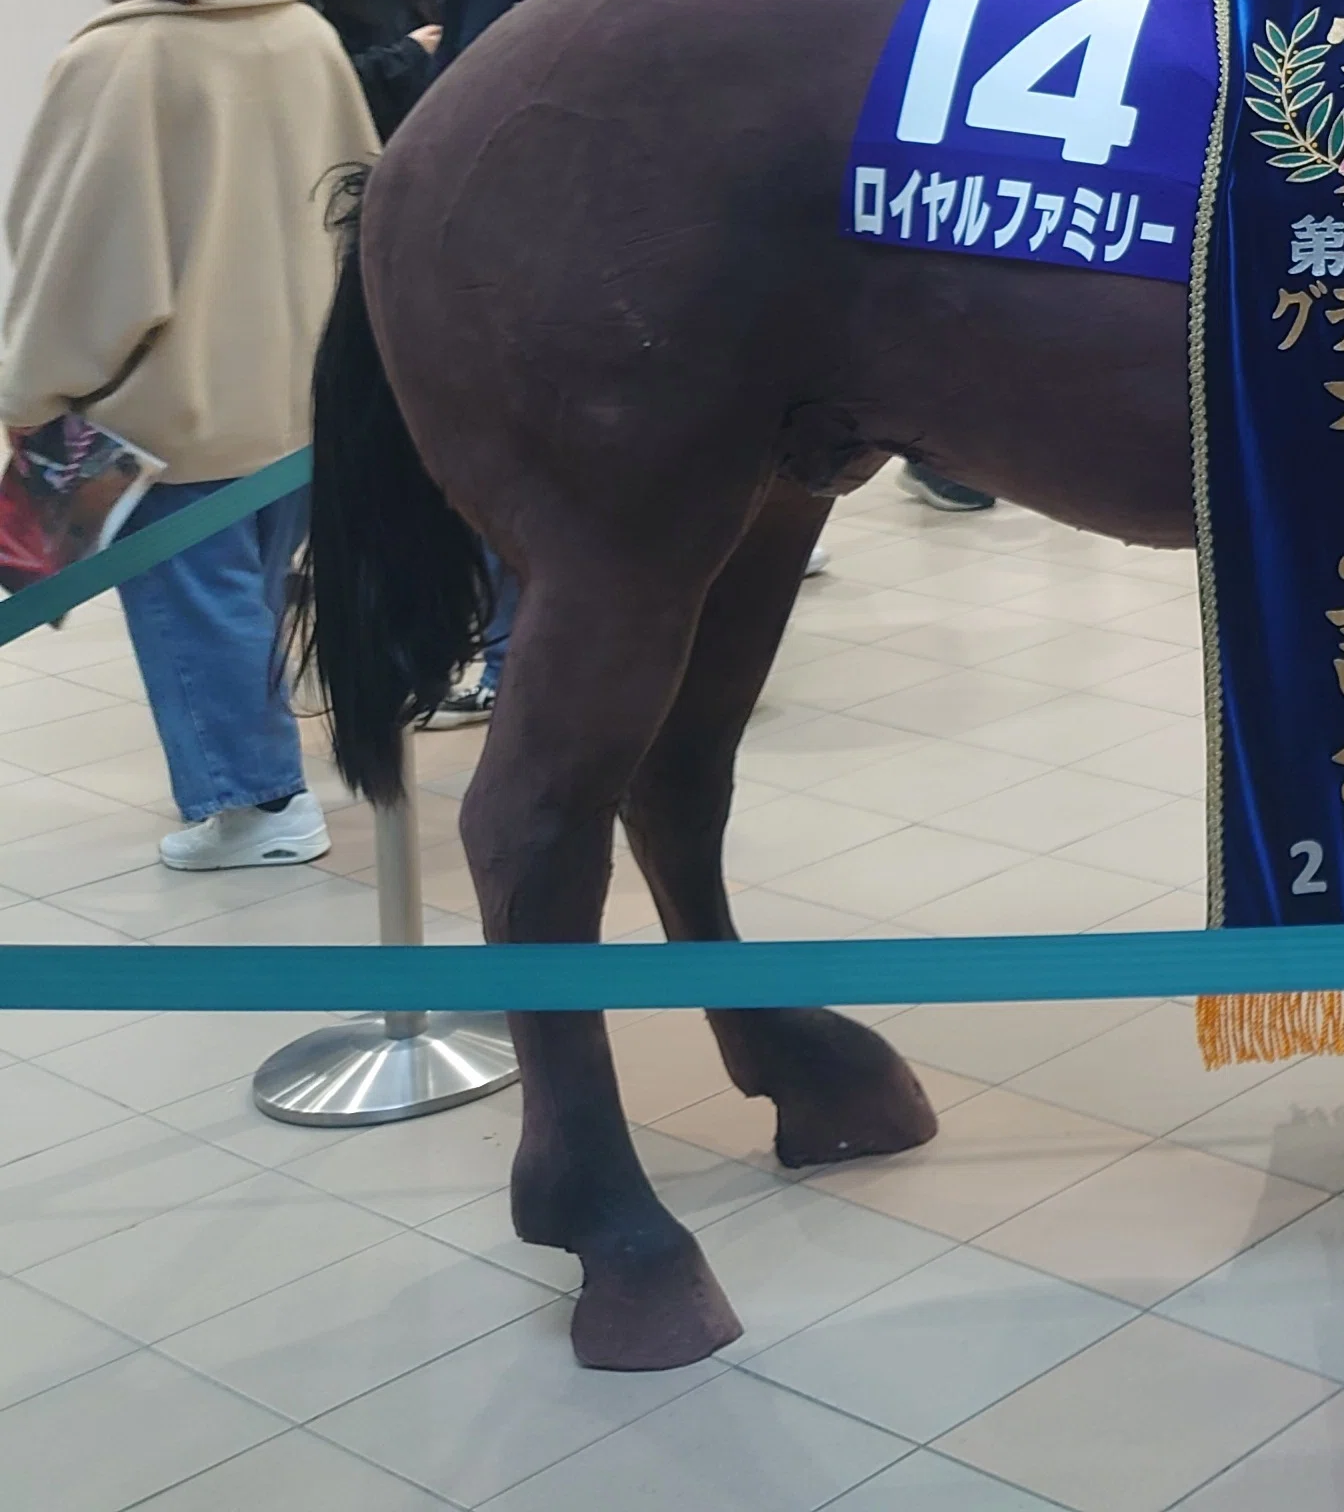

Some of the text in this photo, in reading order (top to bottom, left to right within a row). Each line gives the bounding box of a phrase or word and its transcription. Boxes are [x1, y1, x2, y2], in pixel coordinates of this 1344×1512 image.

[854, 167, 1176, 262] ロイヤルファミリー
